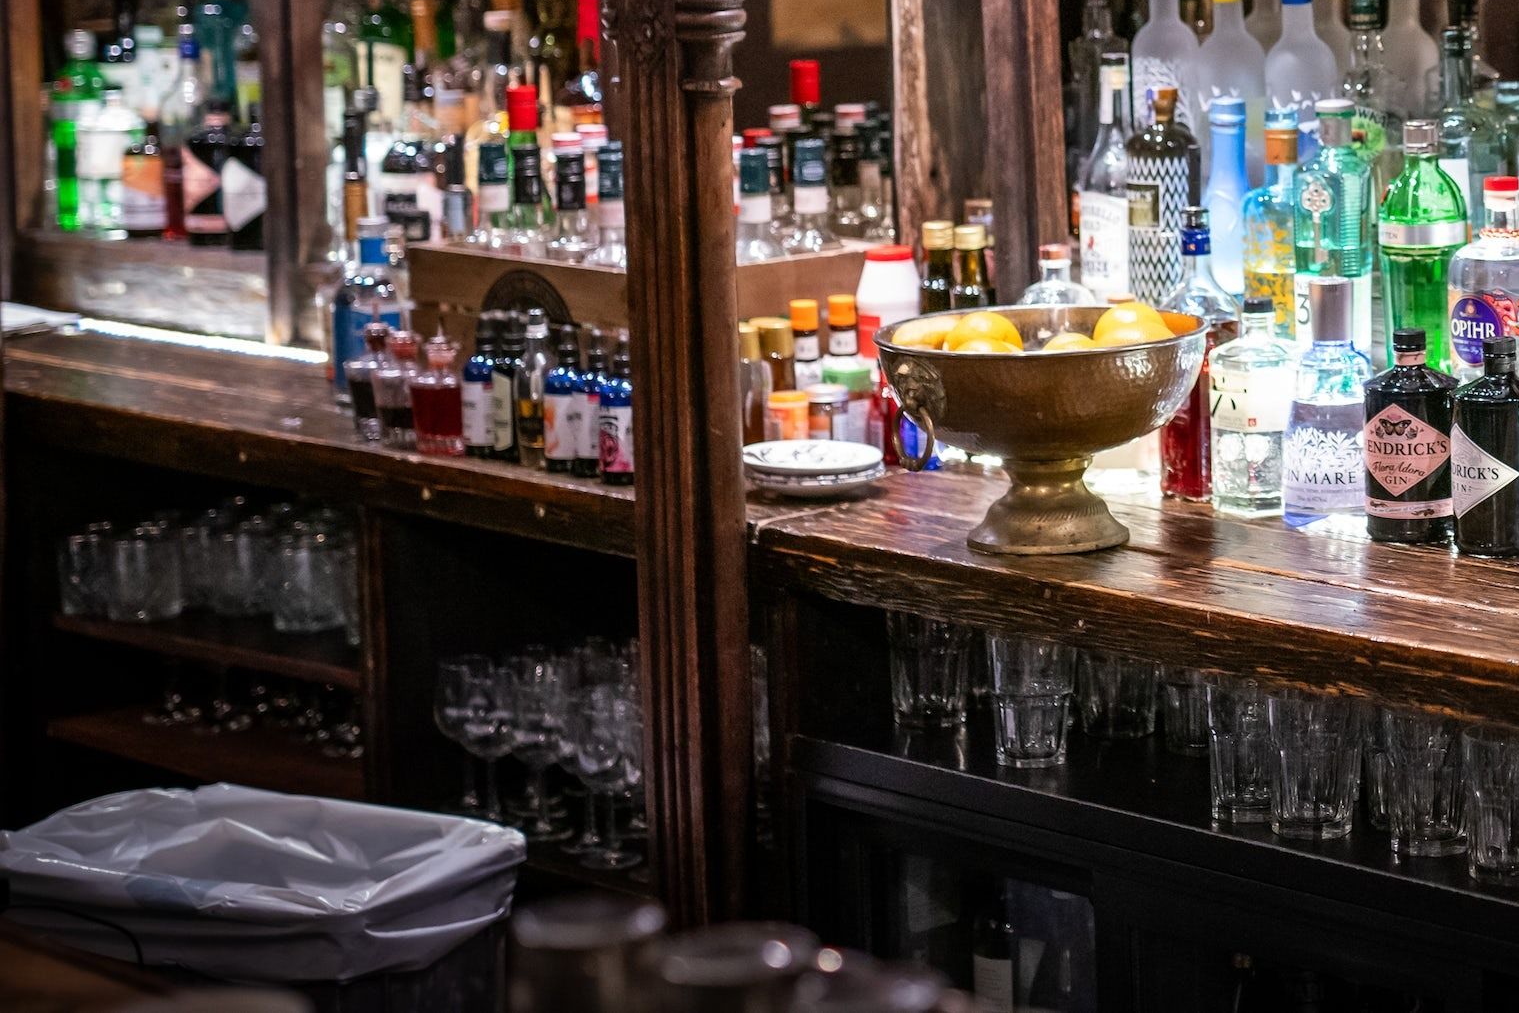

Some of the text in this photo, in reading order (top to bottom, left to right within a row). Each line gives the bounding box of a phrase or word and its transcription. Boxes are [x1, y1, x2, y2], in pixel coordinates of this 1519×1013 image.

[1297, 293, 1310, 326] 3
[1451, 318, 1496, 340] OPIHR
[1303, 470, 1358, 486] MARE
[1383, 475, 1408, 485] GIN
